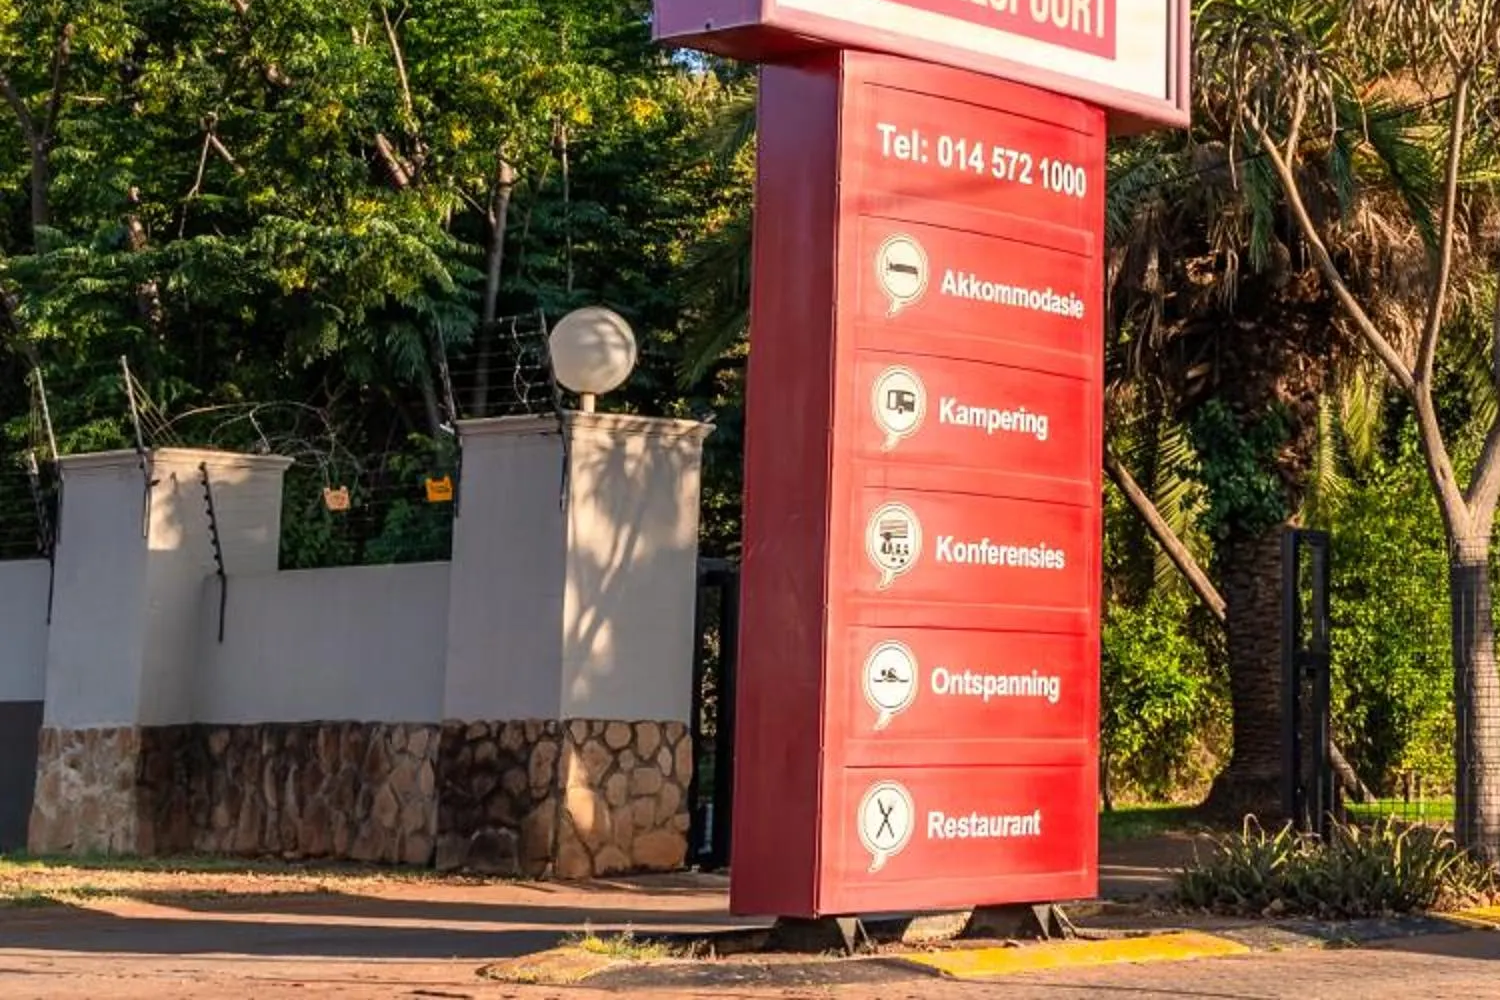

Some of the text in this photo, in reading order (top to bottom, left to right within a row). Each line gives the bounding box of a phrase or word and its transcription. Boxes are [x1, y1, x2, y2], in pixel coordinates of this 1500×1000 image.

[877, 122, 1086, 198] Tel: 014 572 1000
[940, 270, 1084, 319] Akkommodasie
[939, 397, 1049, 440] Kampering
[936, 536, 1065, 569] Konferensies
[931, 669, 1060, 702] Ontspanning
[928, 811, 1041, 839] Restaurant
